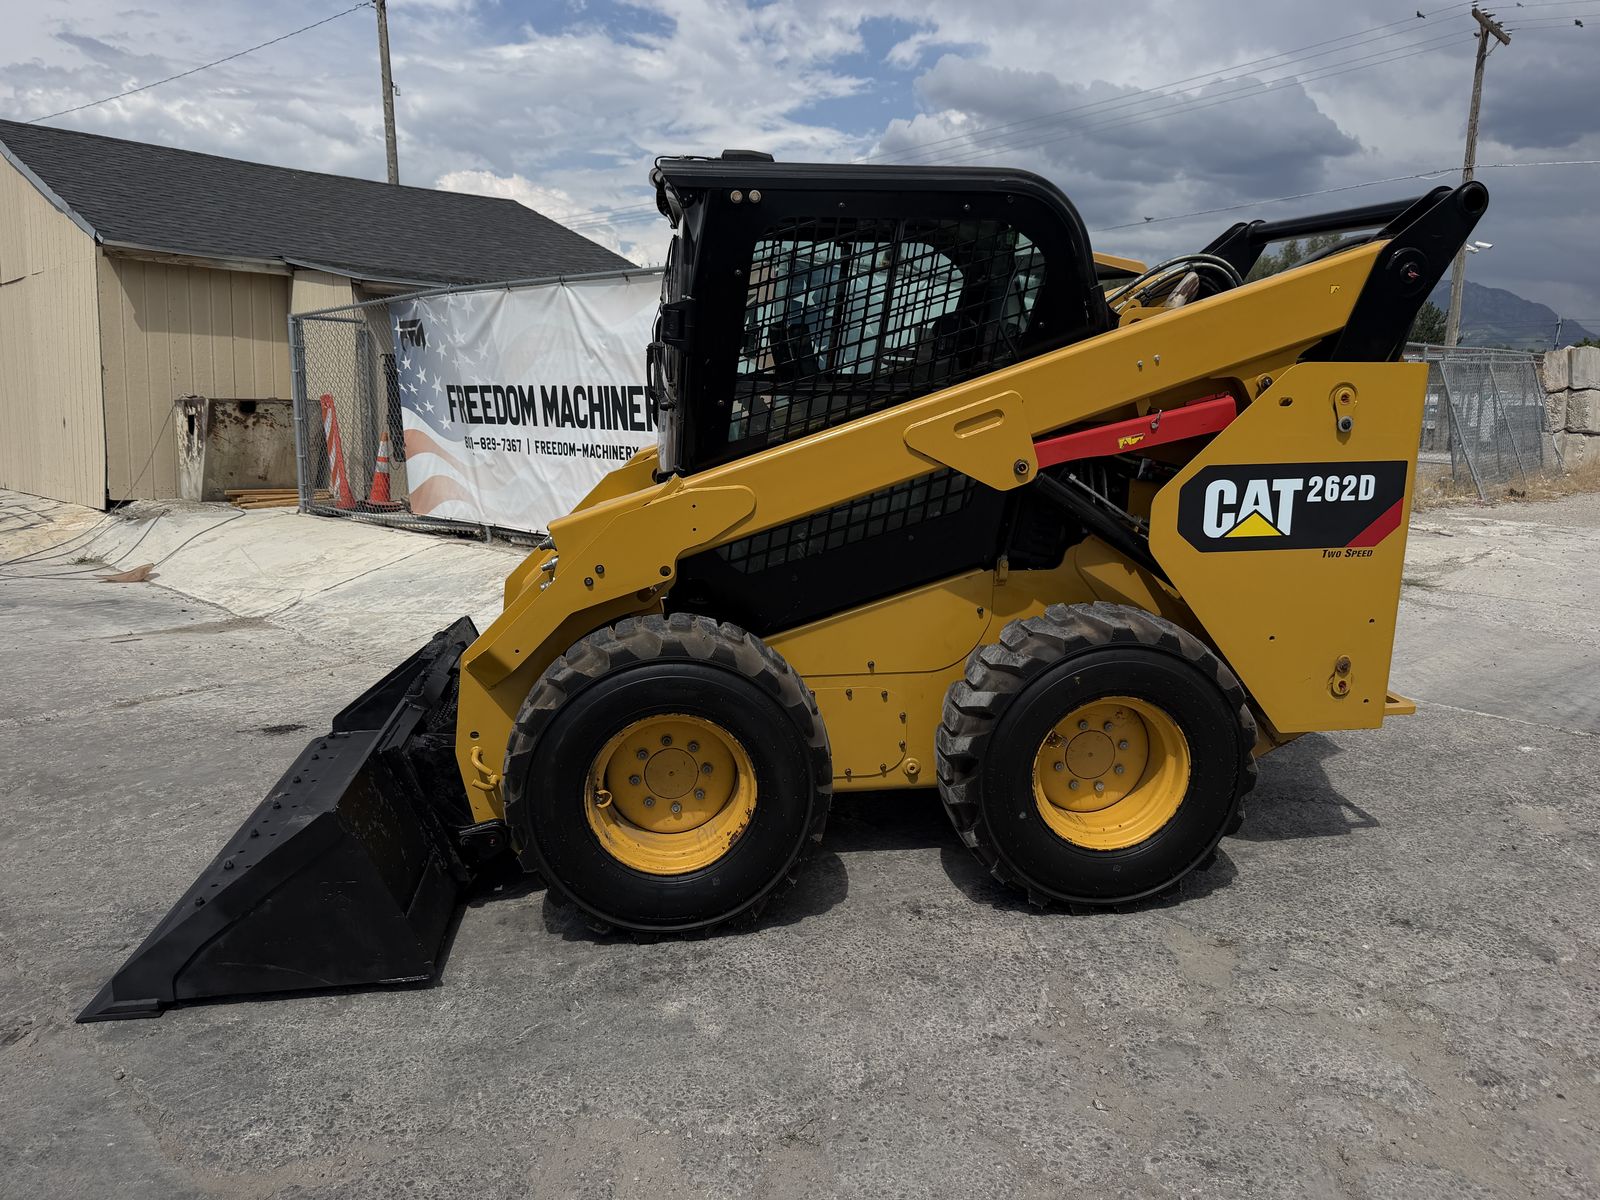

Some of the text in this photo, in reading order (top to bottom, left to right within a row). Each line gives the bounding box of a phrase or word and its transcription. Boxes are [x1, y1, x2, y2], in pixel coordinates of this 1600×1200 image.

[446, 384, 537, 426] FREEDOM
[1203, 474, 1376, 538] CAT 262D
